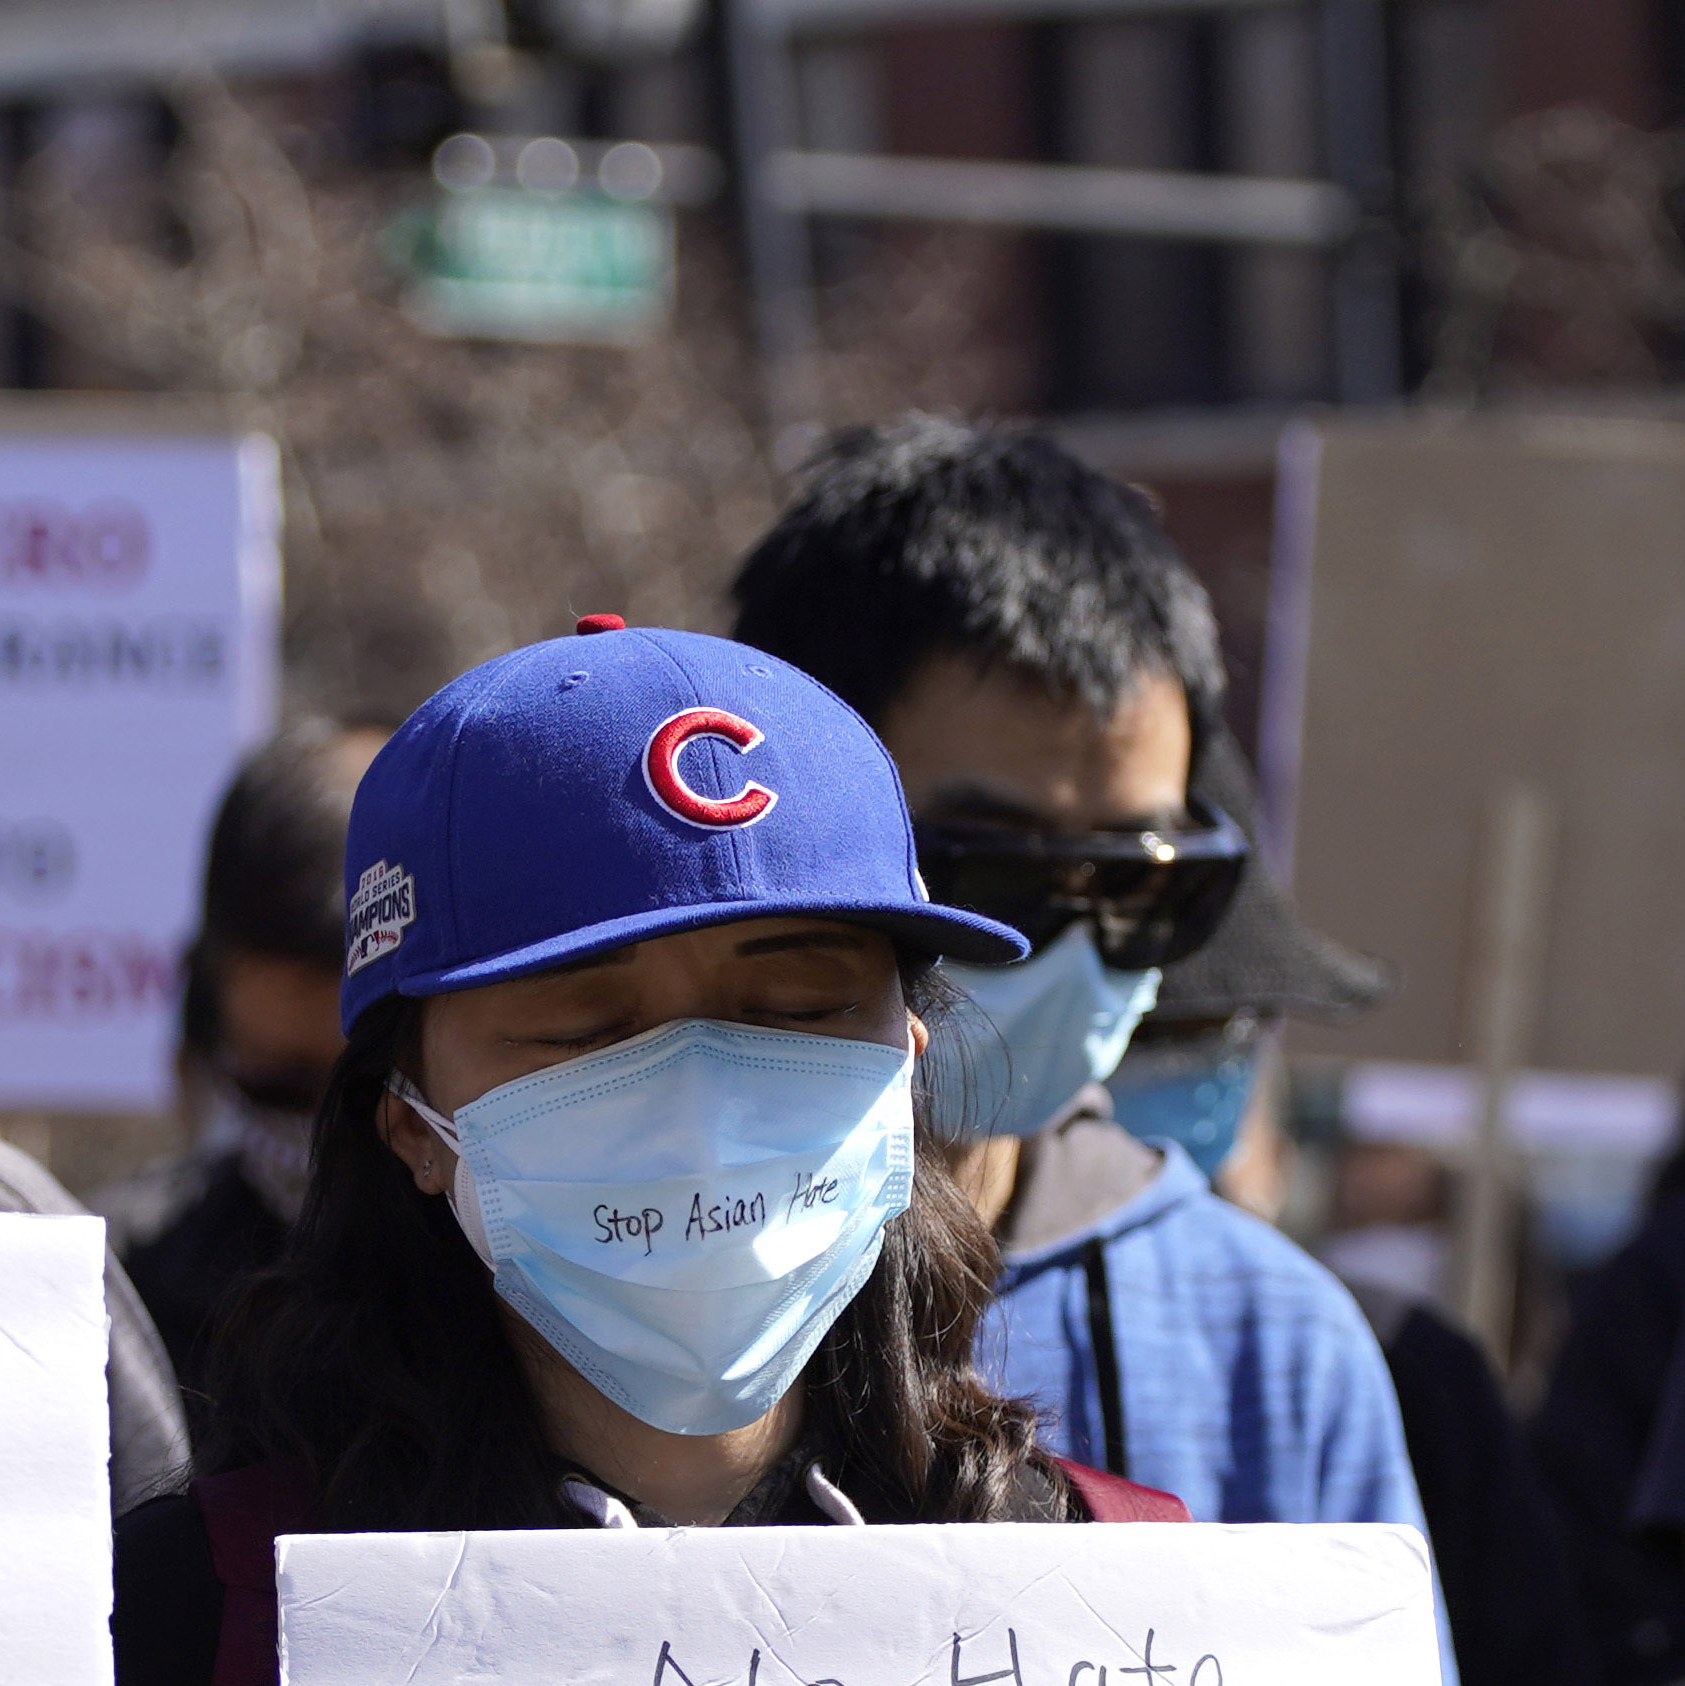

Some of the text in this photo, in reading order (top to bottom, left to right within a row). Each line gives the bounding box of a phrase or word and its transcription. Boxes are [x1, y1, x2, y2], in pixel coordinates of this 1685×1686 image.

[642, 706, 779, 831] C
[372, 871, 401, 898] SERIES
[593, 1172, 839, 1257] Stop Asian Hate
